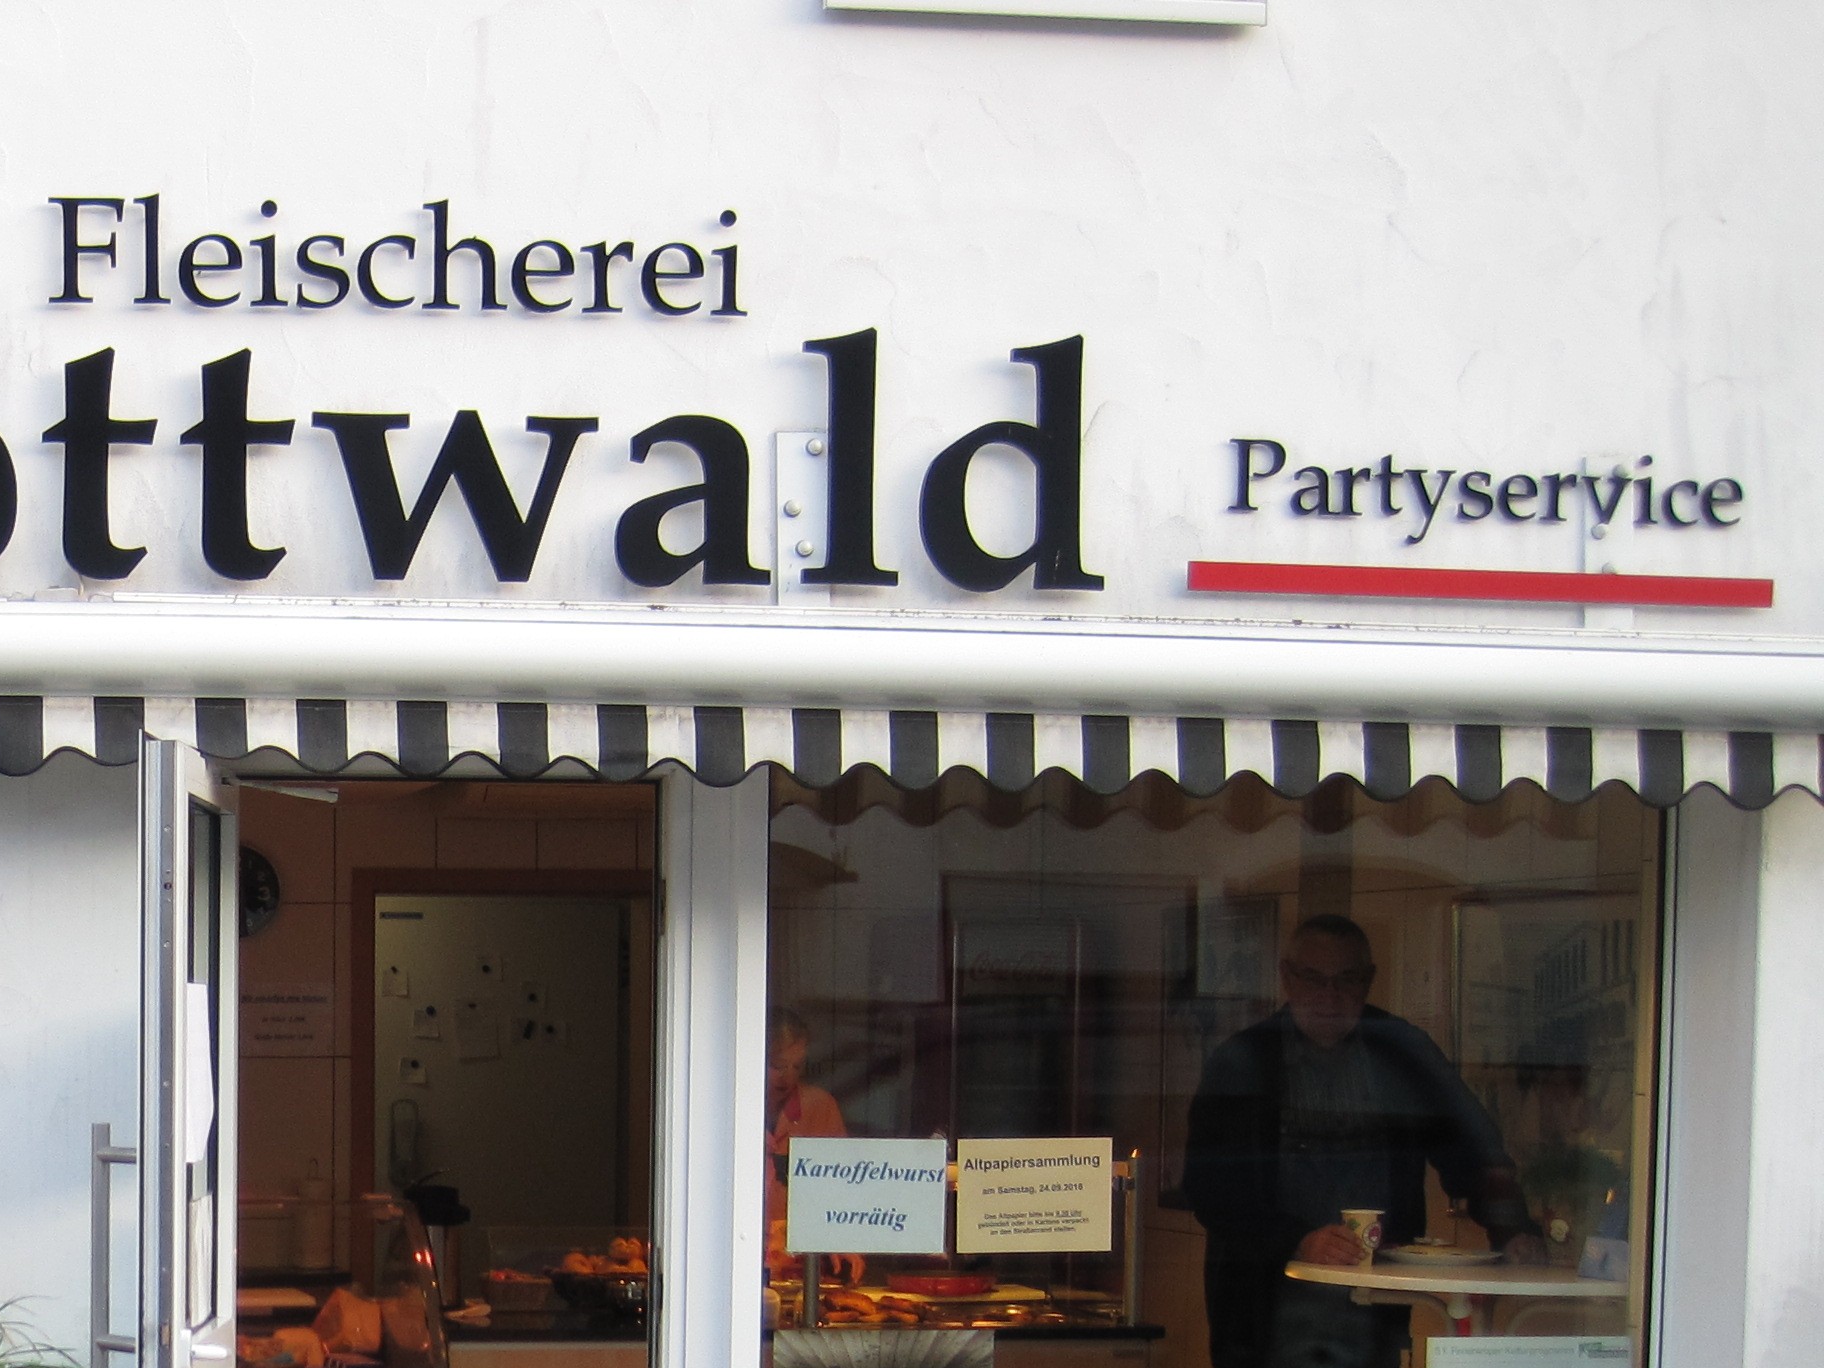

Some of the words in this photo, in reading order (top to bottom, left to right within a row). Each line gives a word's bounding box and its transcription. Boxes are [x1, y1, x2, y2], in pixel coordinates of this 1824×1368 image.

[47, 193, 749, 319] Fleischerei
[1227, 438, 1743, 545] Partyservice
[794, 1157, 945, 1185] Kartoffelwurst
[963, 1154, 1101, 1173] Altpapiersammlung
[826, 1207, 907, 1231] vorrätig
